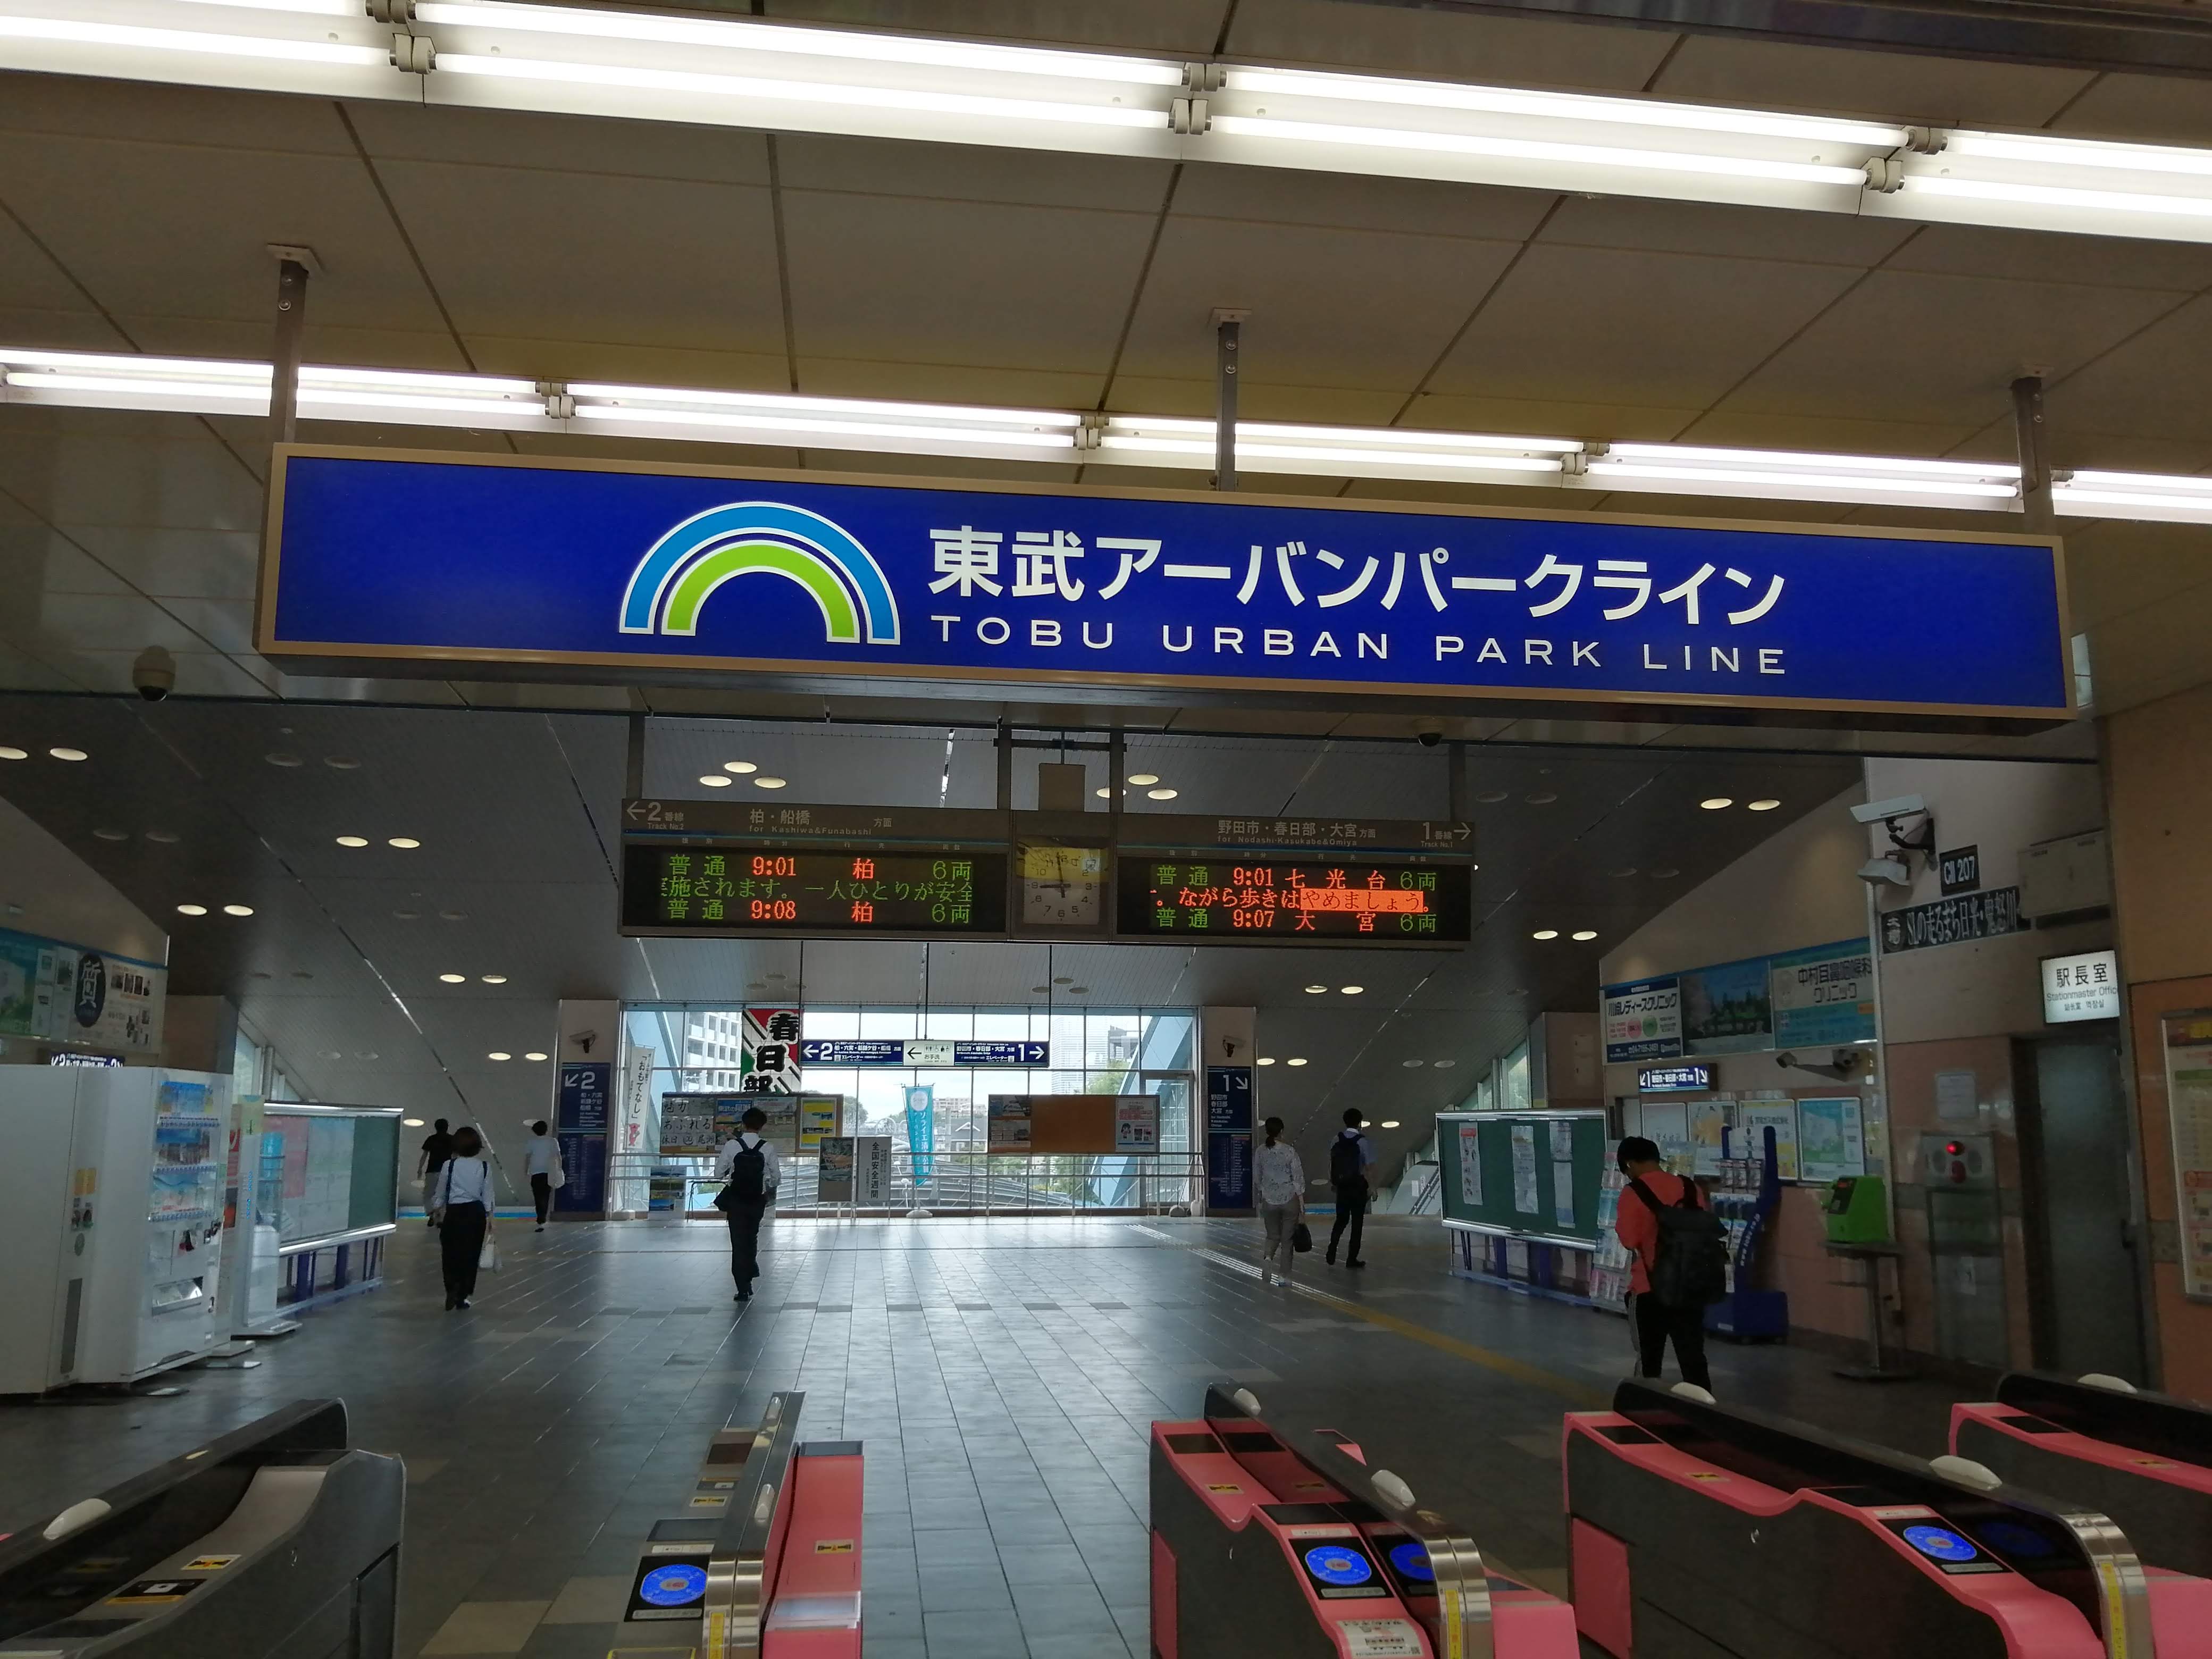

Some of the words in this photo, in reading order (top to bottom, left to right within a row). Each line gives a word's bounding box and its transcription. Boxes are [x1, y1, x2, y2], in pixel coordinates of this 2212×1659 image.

[928, 525, 1785, 625] 東武アーバンパークライン
[931, 615, 1112, 649] TOBU
[1163, 625, 1387, 659] URBAN
[1436, 635, 1601, 667] PARK
[1644, 643, 1785, 674] LINE
[772, 826, 872, 835] Kashiwa&Funabashi
[874, 818, 892, 828] 方面
[669, 854, 725, 876] 普通
[752, 856, 797, 876] 9:01
[853, 858, 874, 879] 柏
[933, 860, 971, 881] 6両
[1157, 865, 1208, 886] 普通
[1234, 867, 1273, 886] 9:01
[1285, 868, 1386, 890] 七光台
[1400, 872, 1436, 891] 6両
[1958, 856, 1975, 882] 207
[661, 876, 972, 902] 施されます。一人ひとりが安全
[667, 899, 724, 920] 普通
[751, 900, 797, 919] 9:08
[852, 901, 873, 923] 柏
[932, 904, 970, 924] 6両
[1156, 907, 1208, 928] 普通
[1233, 909, 1275, 928] 9:07
[1295, 910, 1376, 932] 大宮
[1400, 913, 1436, 933] 6両
[2057, 963, 2108, 988] 駅長室
[2047, 989, 2097, 1002] Stationmaster
[820, 1043, 833, 1060] 2
[1018, 1044, 1025, 1061] 1
[581, 1071, 595, 1089] 2
[1223, 1075, 1229, 1092] 1
[664, 1118, 711, 1130] あふれる
[871, 1142, 879, 1199] 全国安全週間
